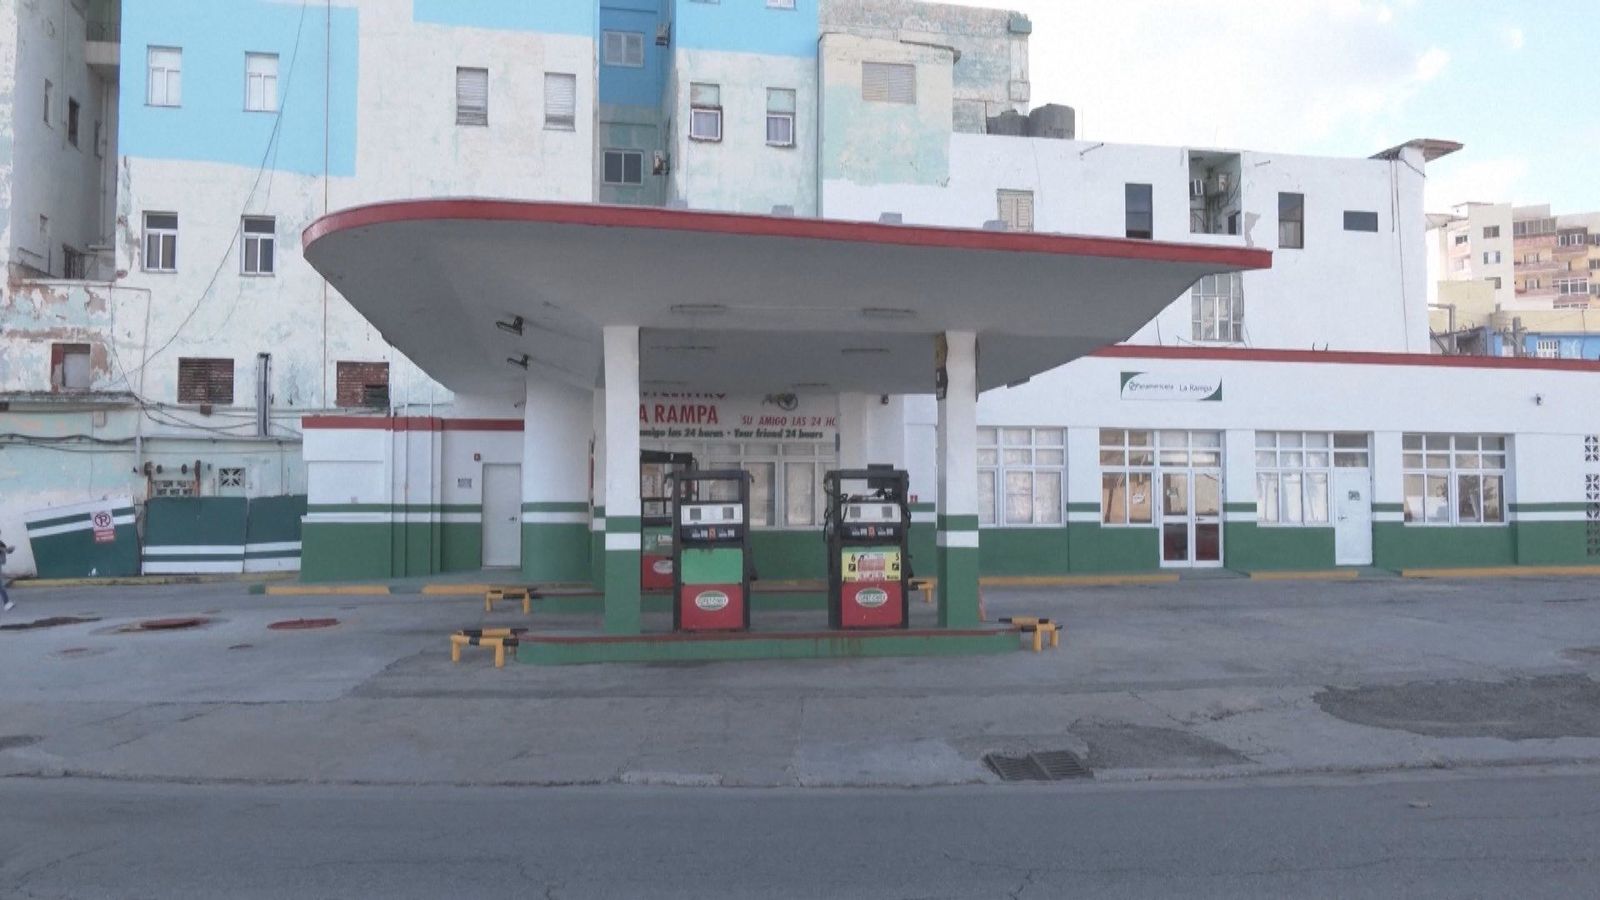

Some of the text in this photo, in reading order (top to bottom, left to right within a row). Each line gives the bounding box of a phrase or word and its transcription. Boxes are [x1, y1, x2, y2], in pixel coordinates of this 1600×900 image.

[1190, 384, 1213, 393] Rampa
[655, 404, 718, 424] RAMPA
[742, 415, 753, 425] SU
[759, 415, 787, 426] AMIGO
[792, 416, 806, 426] LAS
[811, 416, 822, 426] 24
[684, 428, 697, 437] 24
[734, 428, 753, 438] Your
[756, 428, 783, 438] friend
[785, 428, 797, 438] 24
[798, 428, 823, 438] hours
